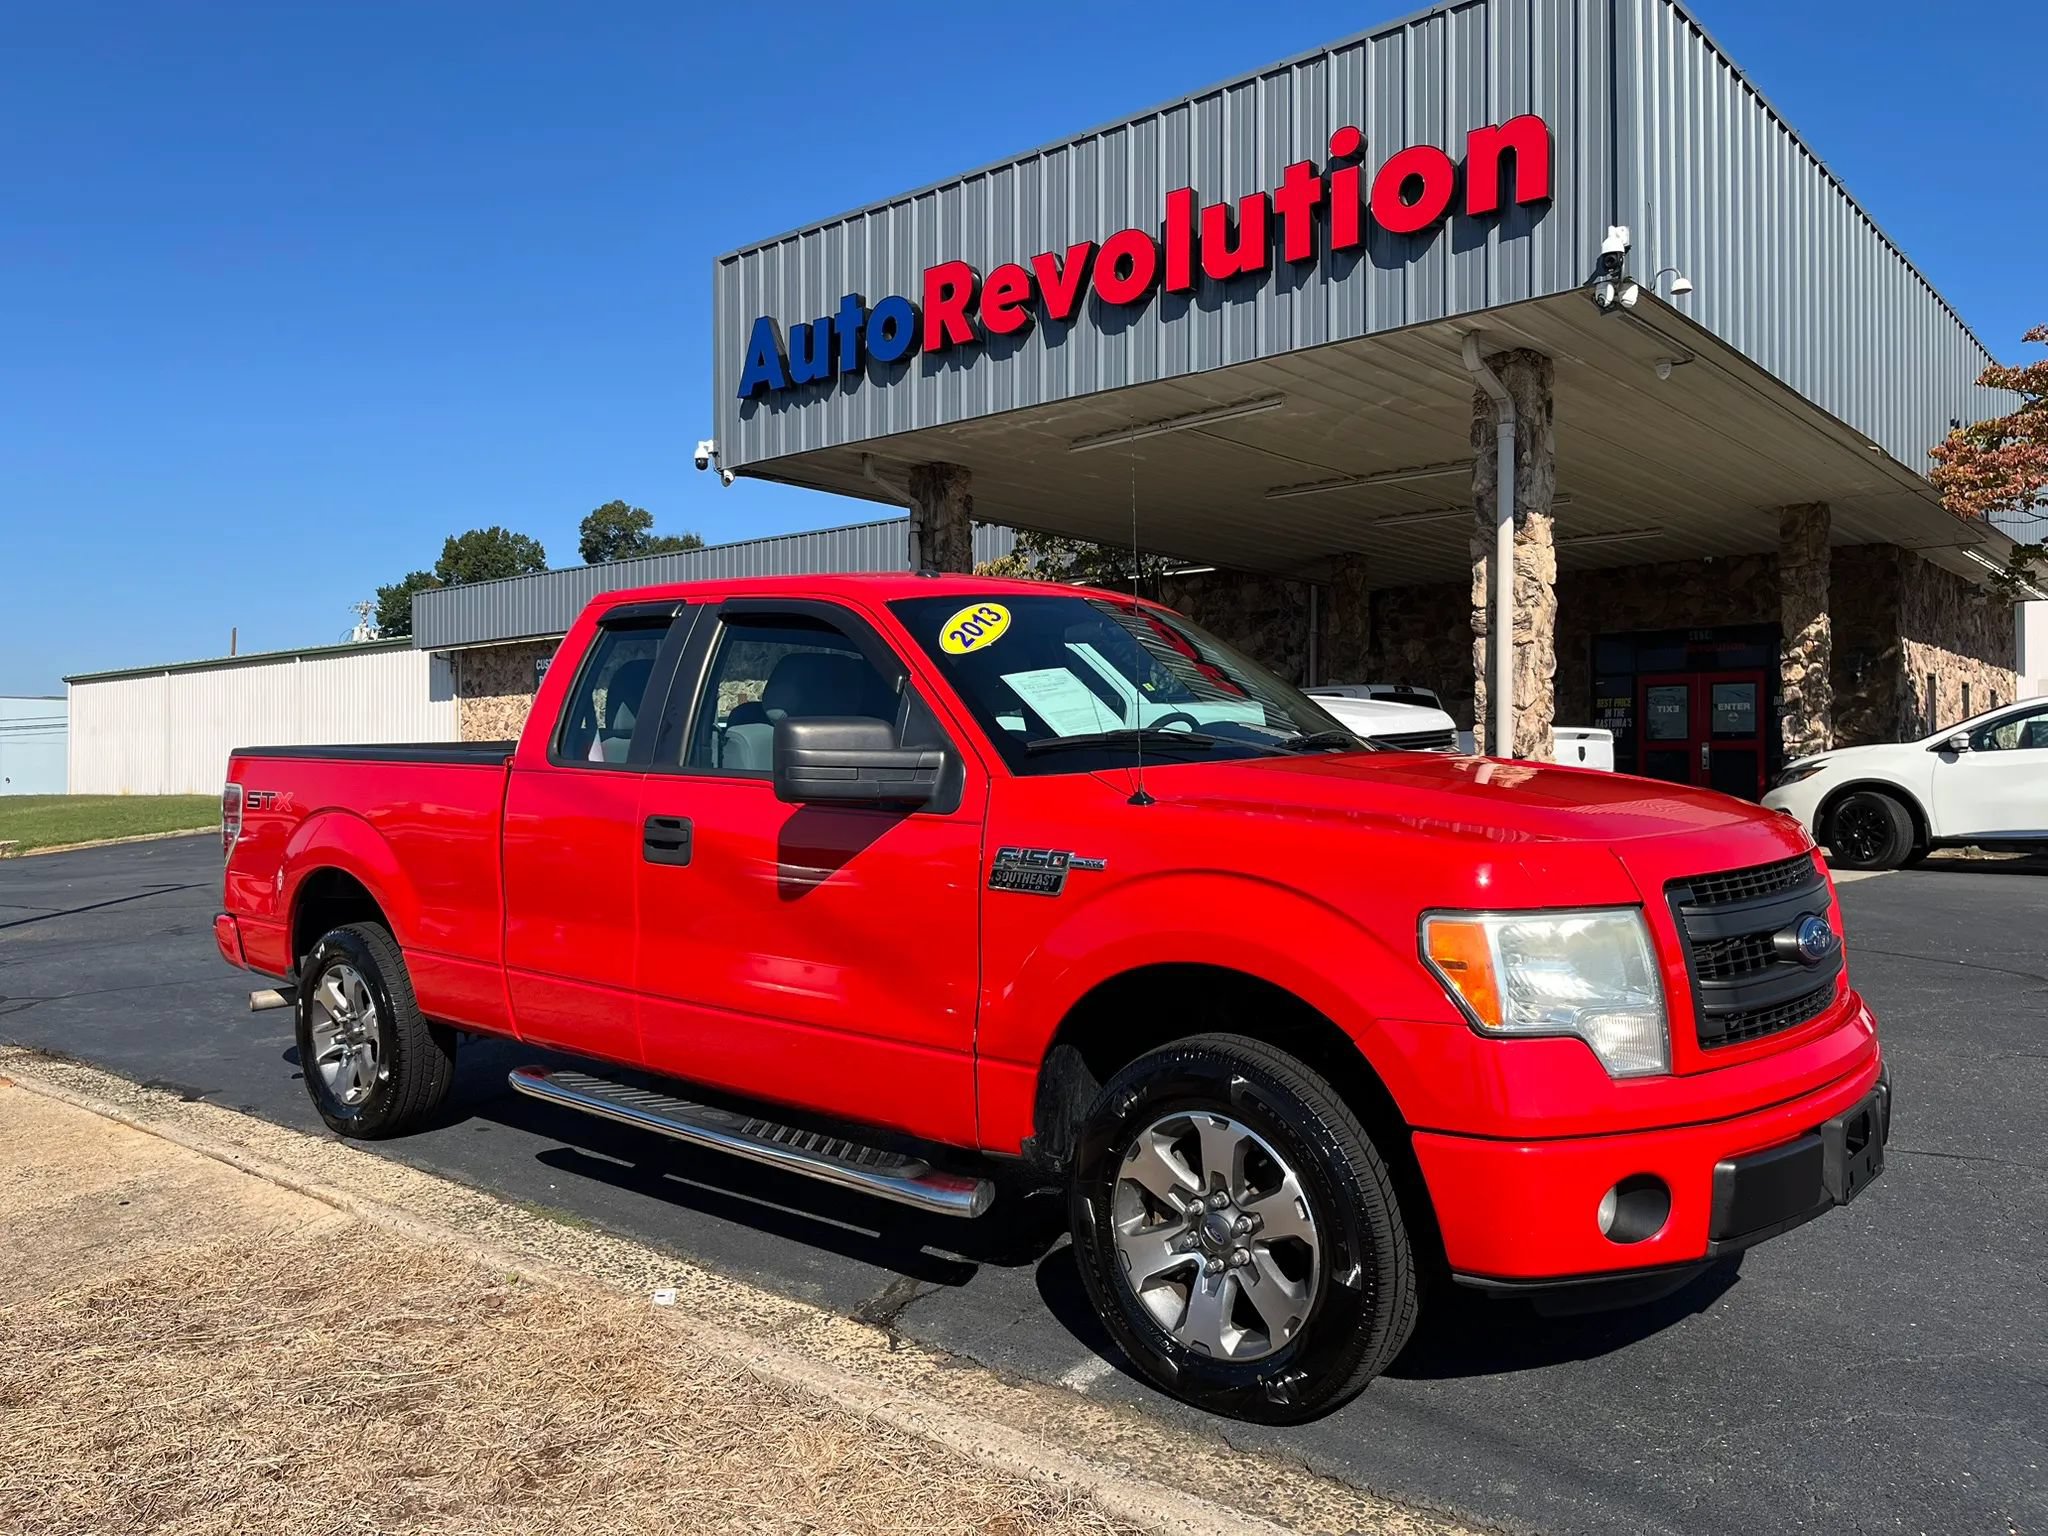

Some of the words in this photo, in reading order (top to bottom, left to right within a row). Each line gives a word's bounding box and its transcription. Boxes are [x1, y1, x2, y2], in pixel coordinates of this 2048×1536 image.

[949, 606, 1002, 649] 2013
[1717, 702, 1751, 711] ENTER
[246, 790, 294, 812] STX
[994, 870, 1058, 887] SOUTHEAST
